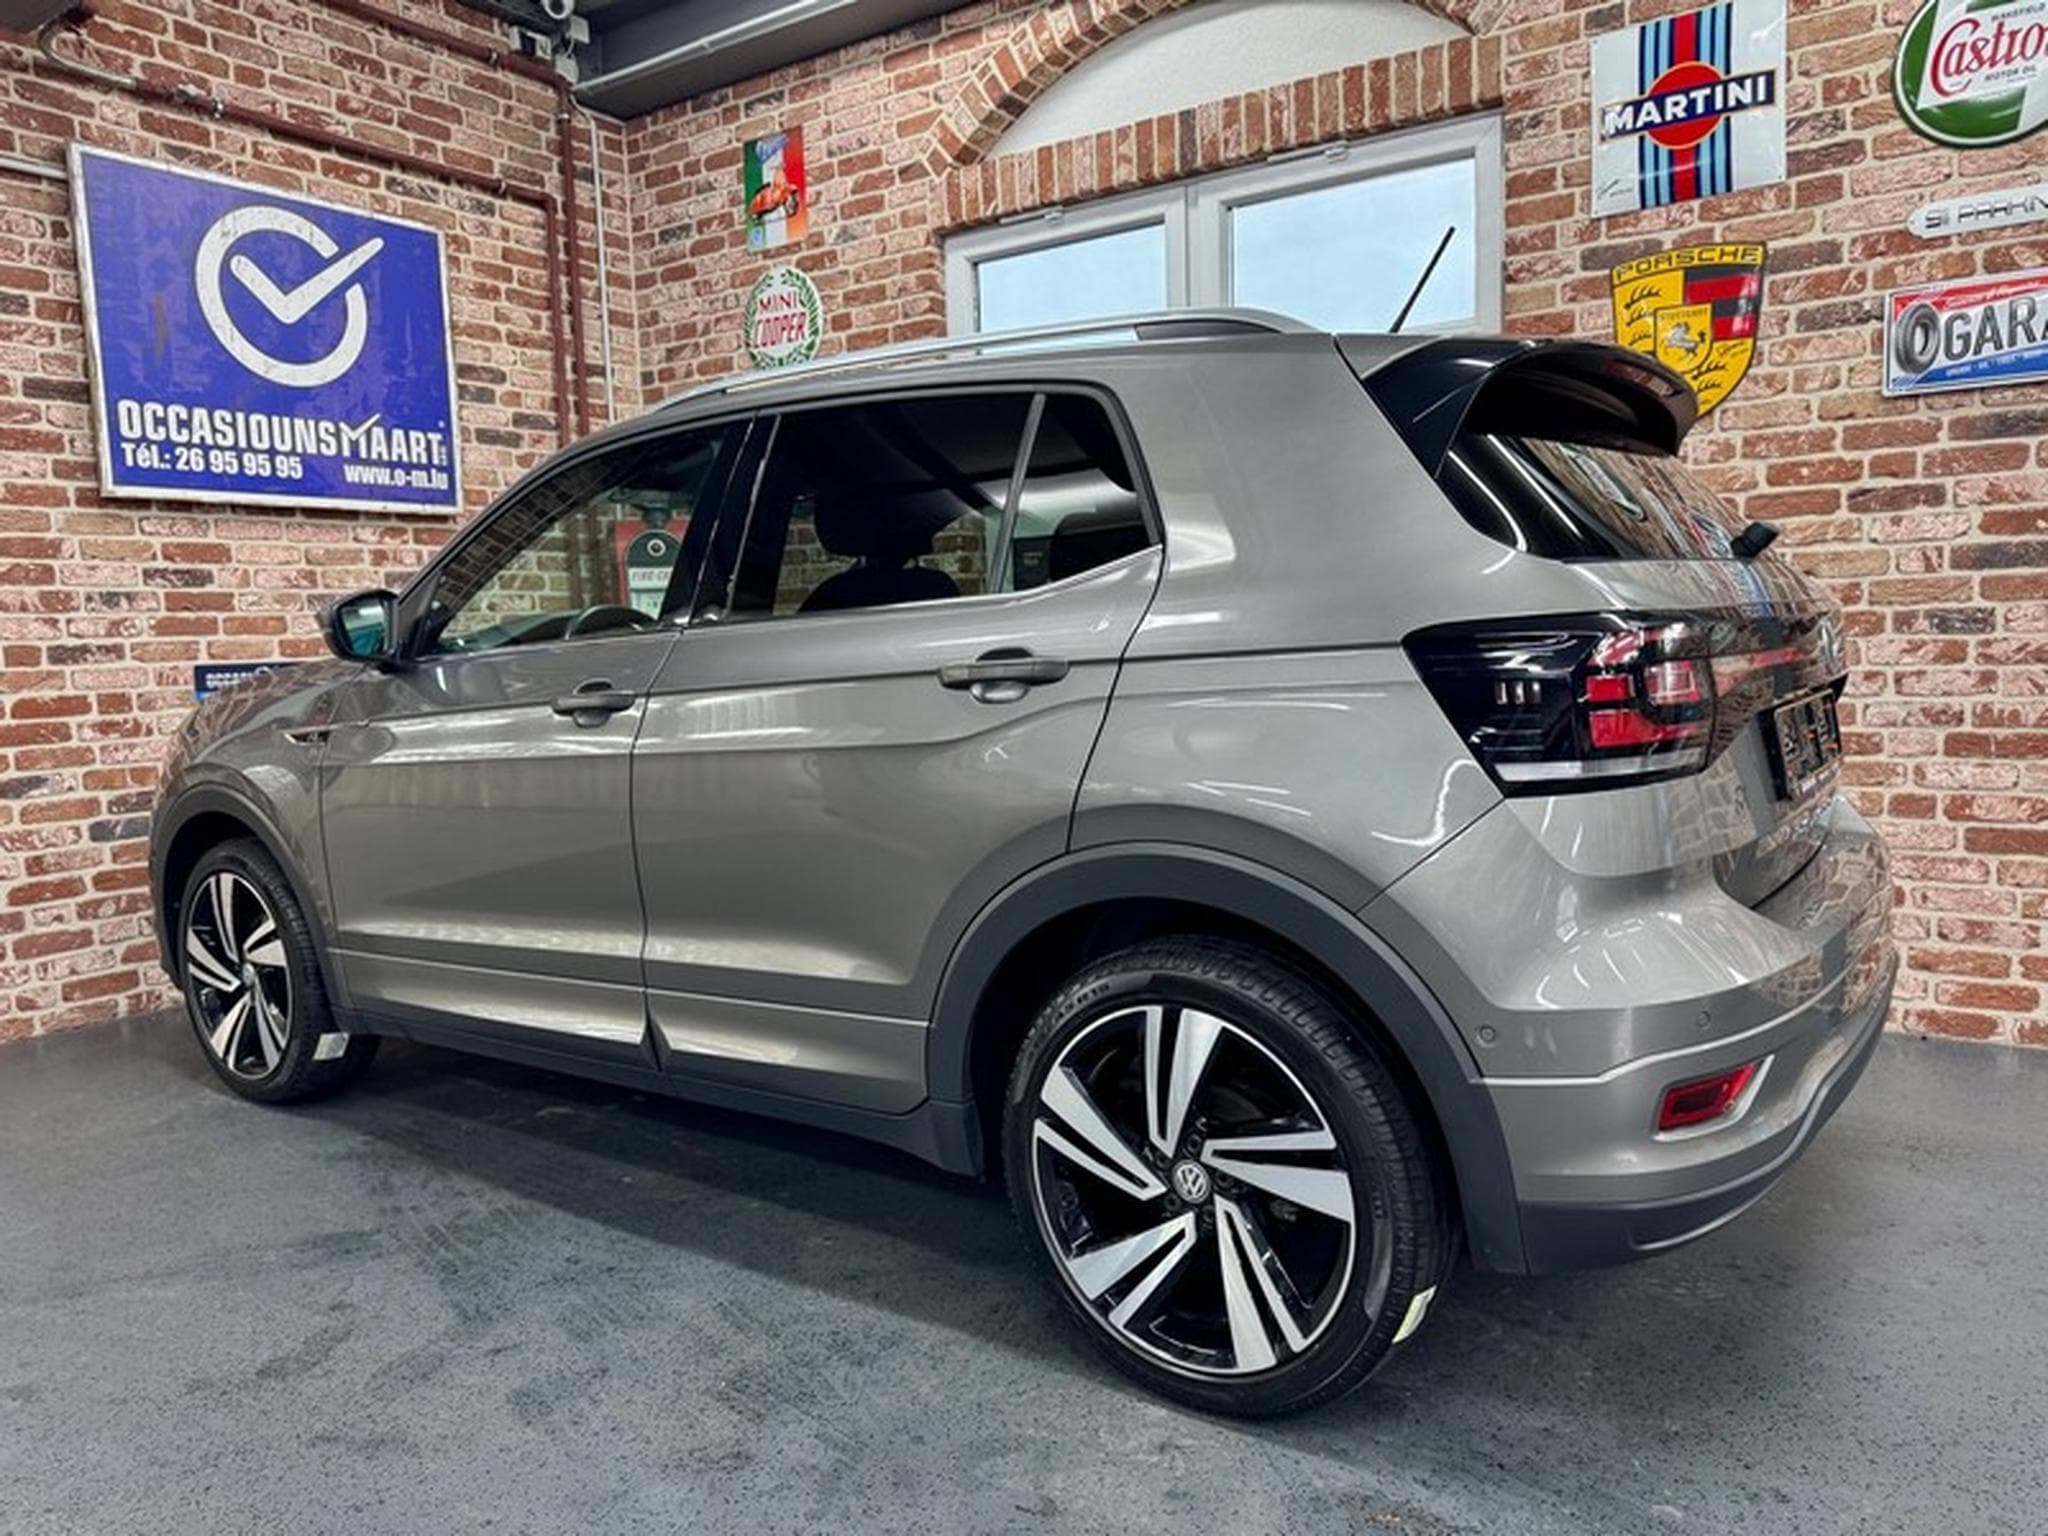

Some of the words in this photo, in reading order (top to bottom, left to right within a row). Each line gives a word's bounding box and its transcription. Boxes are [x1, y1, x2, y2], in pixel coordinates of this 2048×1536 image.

[1931, 18, 2048, 98] Castro
[1603, 75, 1766, 135] MARTINI
[1615, 247, 1759, 281] PORSCHE
[758, 290, 798, 313] MINI
[753, 311, 806, 349] COOPER
[121, 442, 171, 469] Tél.:
[175, 447, 204, 472] 26
[209, 450, 239, 475] 95
[242, 452, 271, 477] 95
[275, 454, 303, 480] 95
[343, 463, 449, 490] www.o-m.lu
